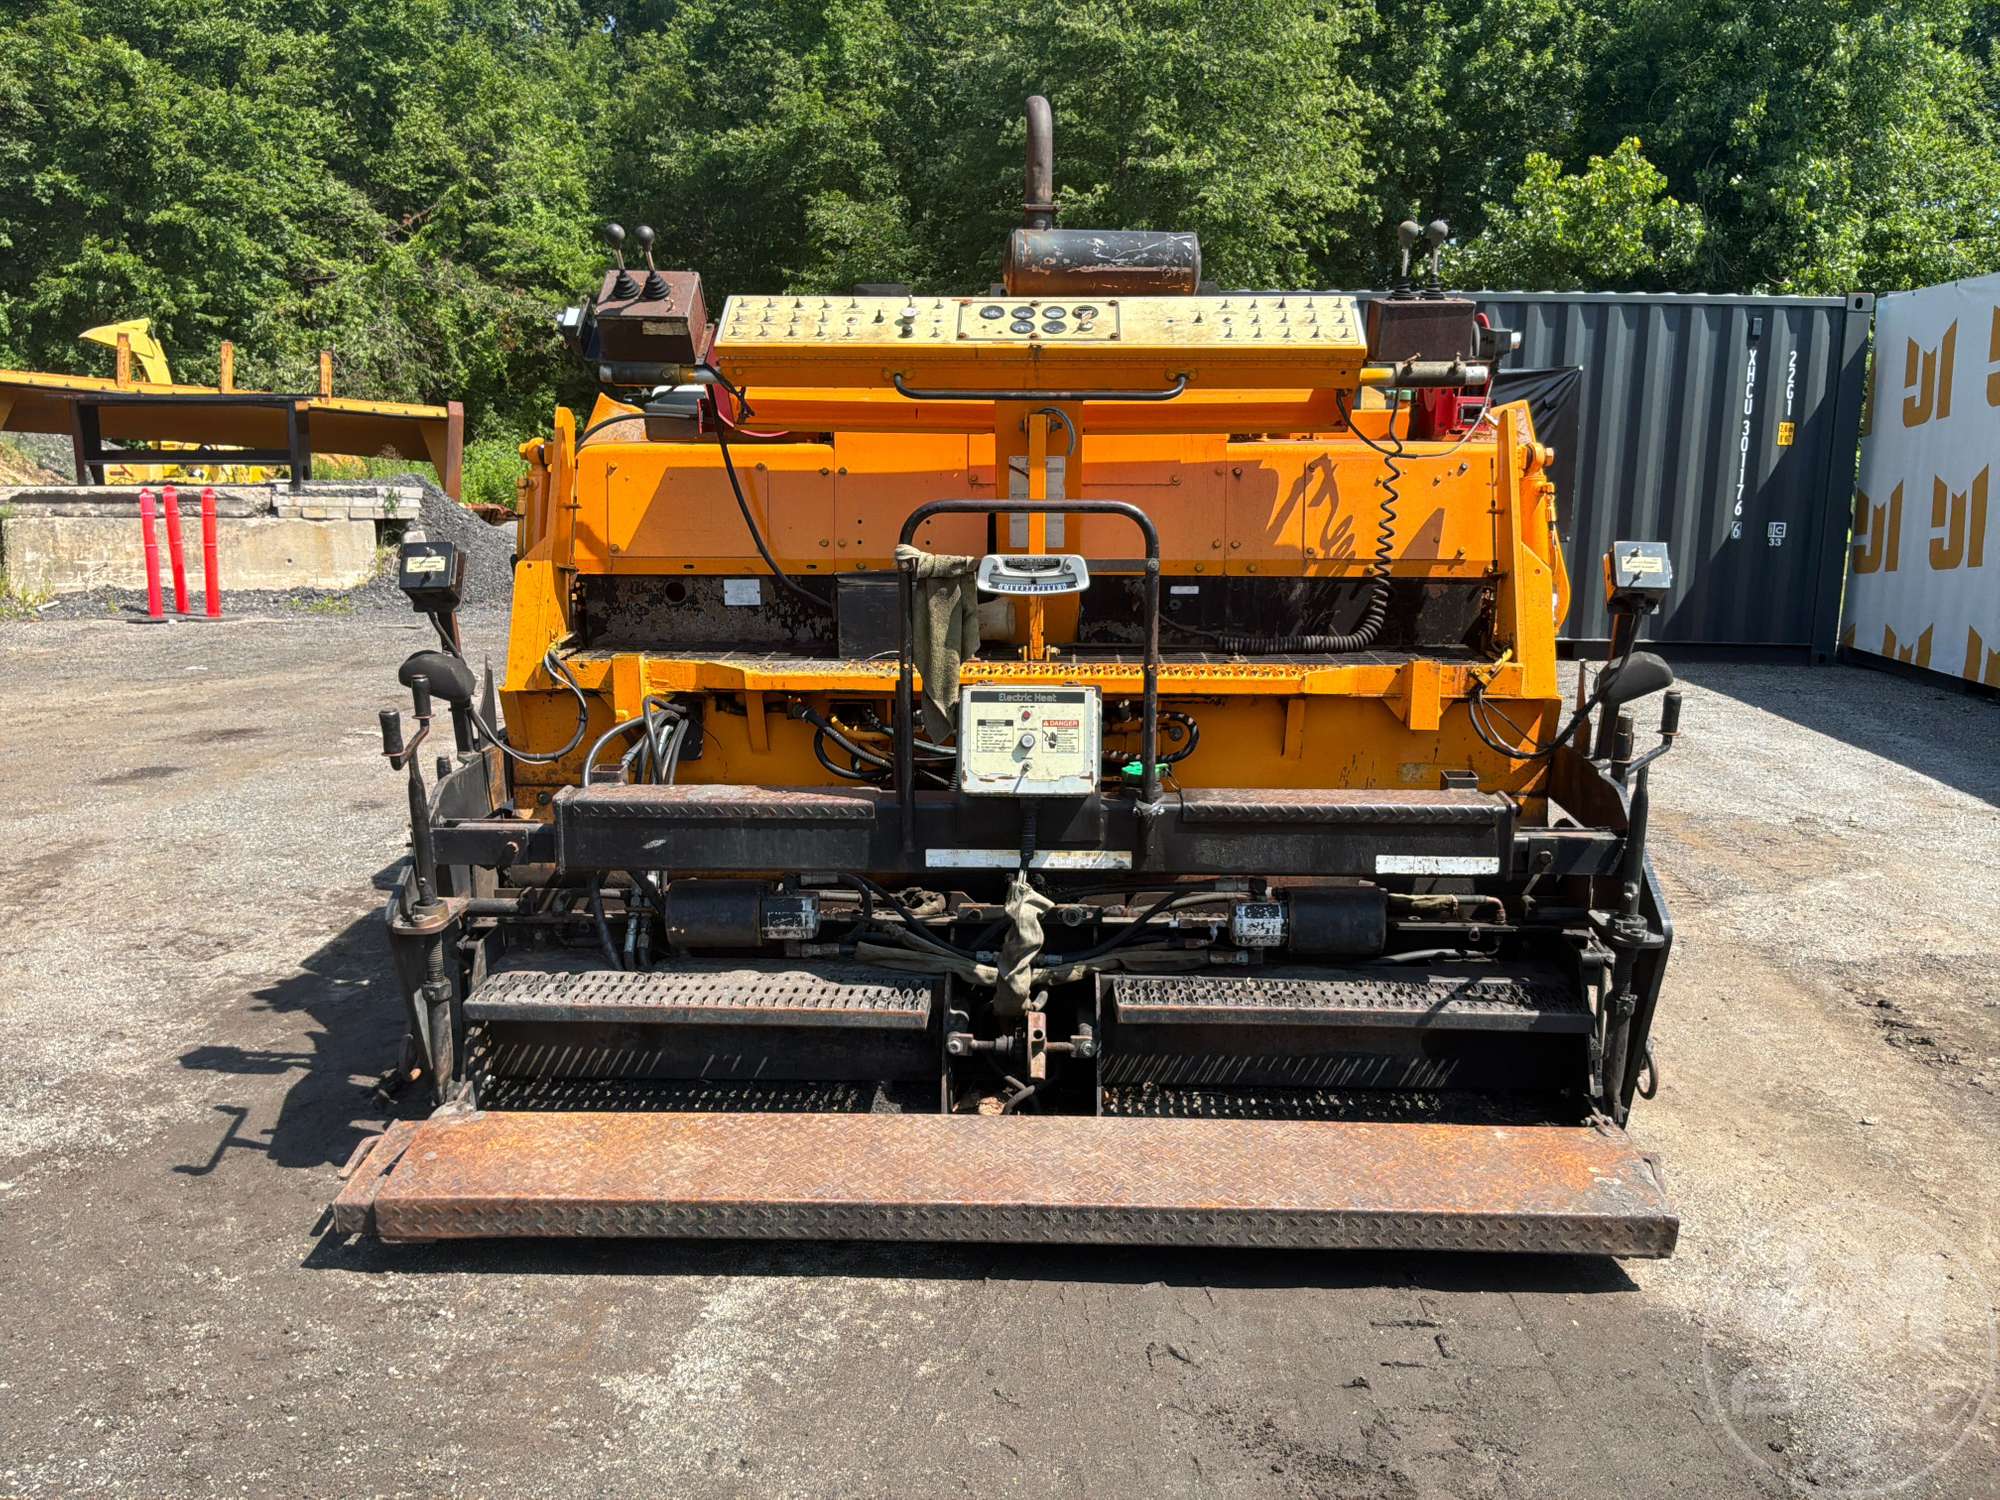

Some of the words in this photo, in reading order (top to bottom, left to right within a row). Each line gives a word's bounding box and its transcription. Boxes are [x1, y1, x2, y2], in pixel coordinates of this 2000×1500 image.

[1744, 350, 1757, 415] XHCU
[1786, 351, 1797, 416] 22G1
[1734, 420, 1750, 516] 301176
[1732, 522, 1741, 538] 6
[1768, 538, 1782, 547] 33
[998, 692, 1032, 702] Electric
[1033, 693, 1057, 702] Heat
